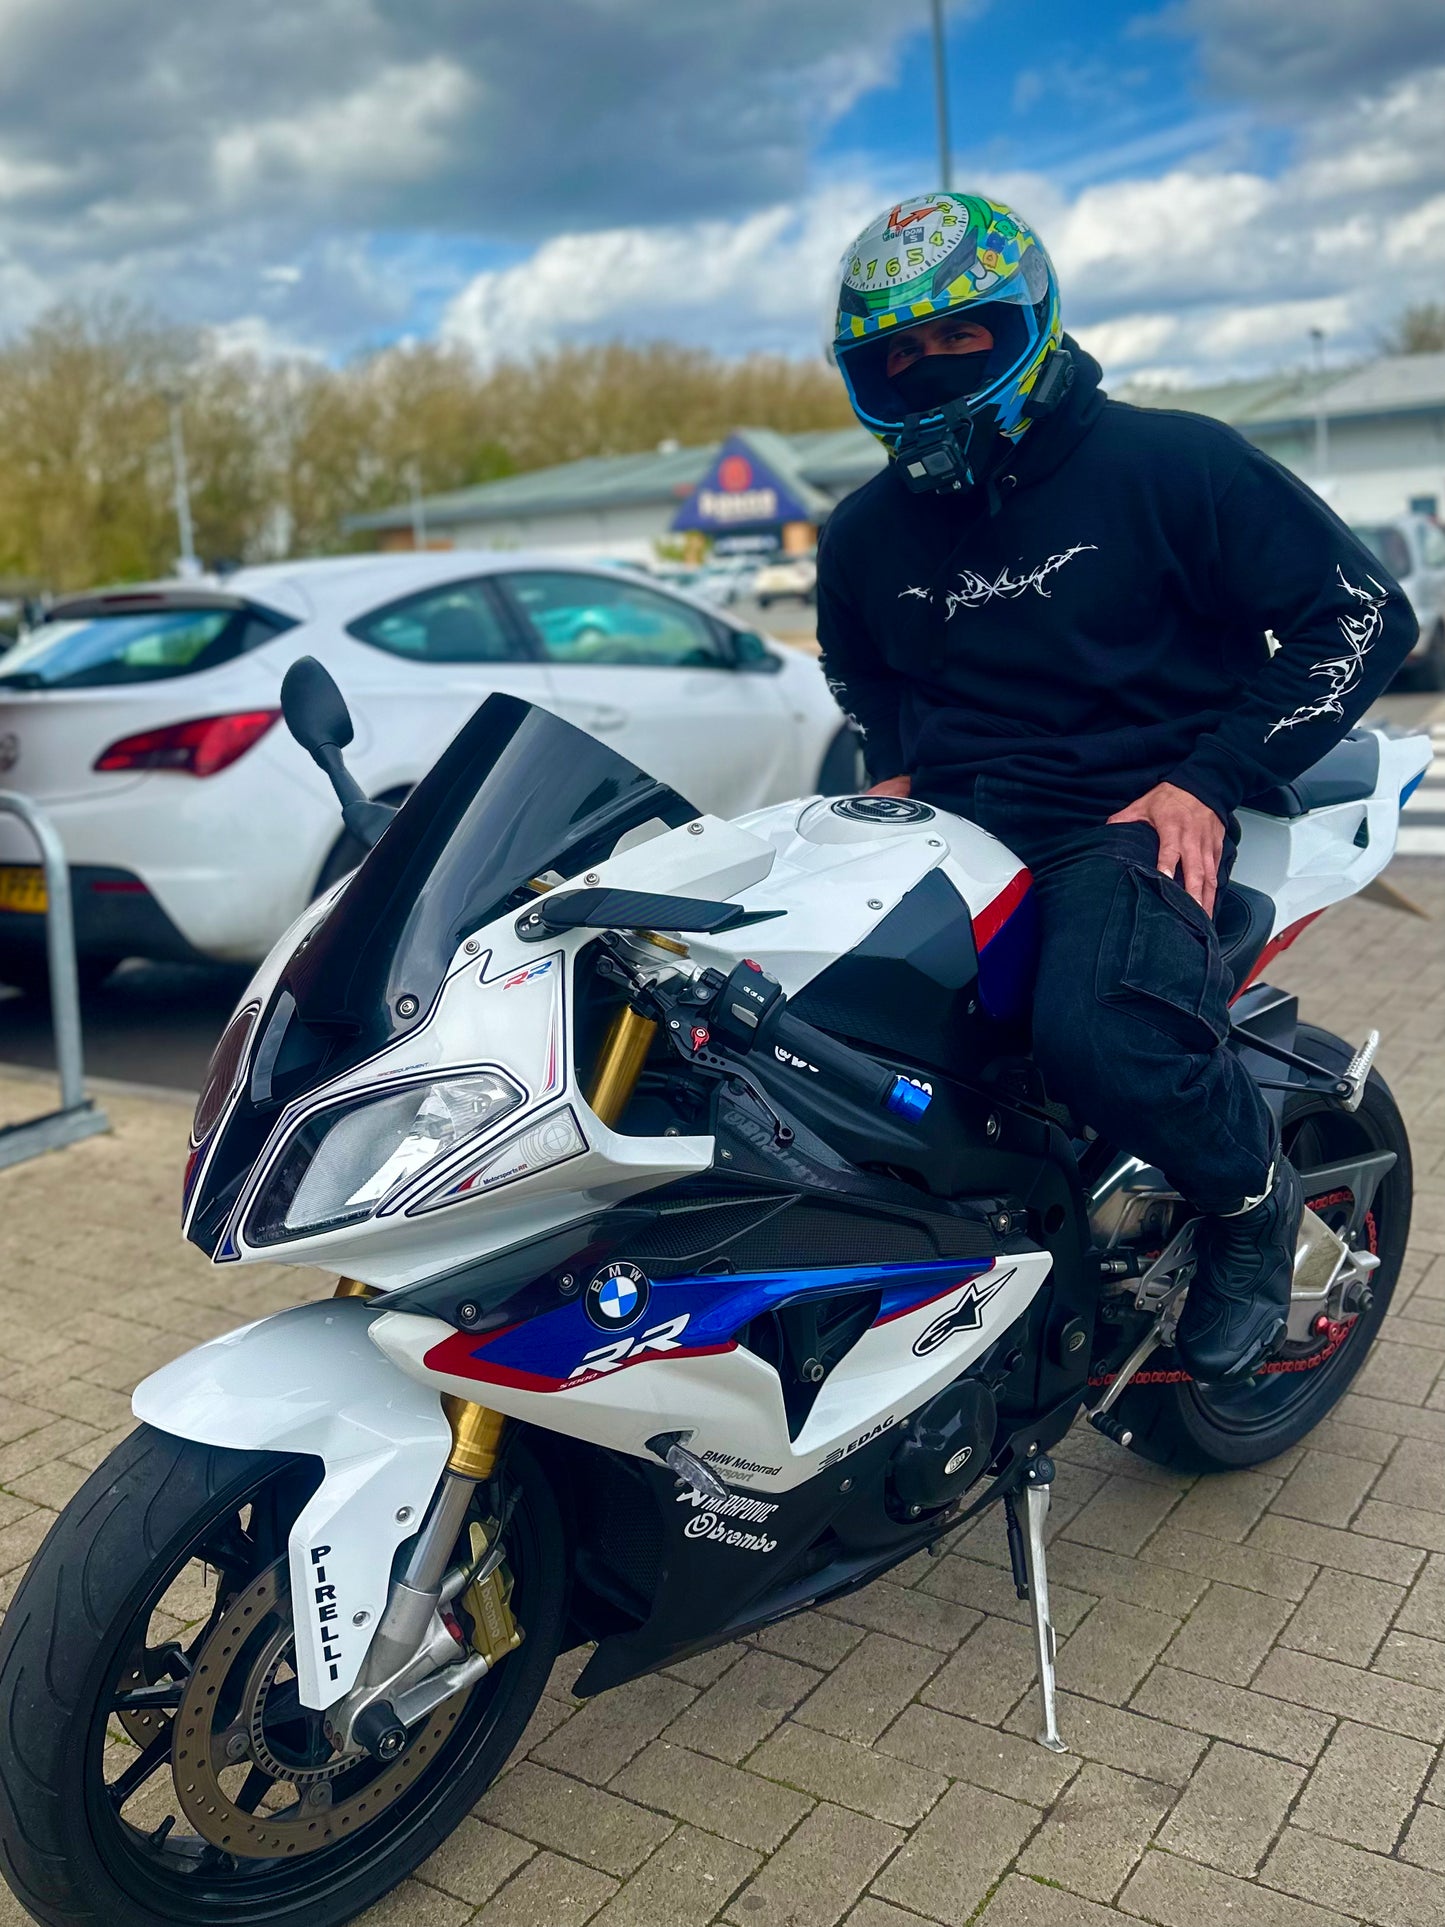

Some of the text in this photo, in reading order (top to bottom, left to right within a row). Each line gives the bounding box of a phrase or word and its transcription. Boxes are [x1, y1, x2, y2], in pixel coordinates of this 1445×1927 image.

[942, 215, 958, 227] 3
[929, 231, 944, 247] 4
[885, 257, 900, 277] 6
[906, 248, 924, 267] 5
[502, 960, 553, 990] RR
[590, 1265, 642, 1293] BMW
[568, 1312, 691, 1380] RR
[846, 1414, 895, 1454] EDAG
[700, 1449, 783, 1477] BMW Motorrad
[706, 1520, 778, 1553] brembo
[310, 1545, 342, 1681] PIRELLI
[481, 1584, 501, 1639] brembo
